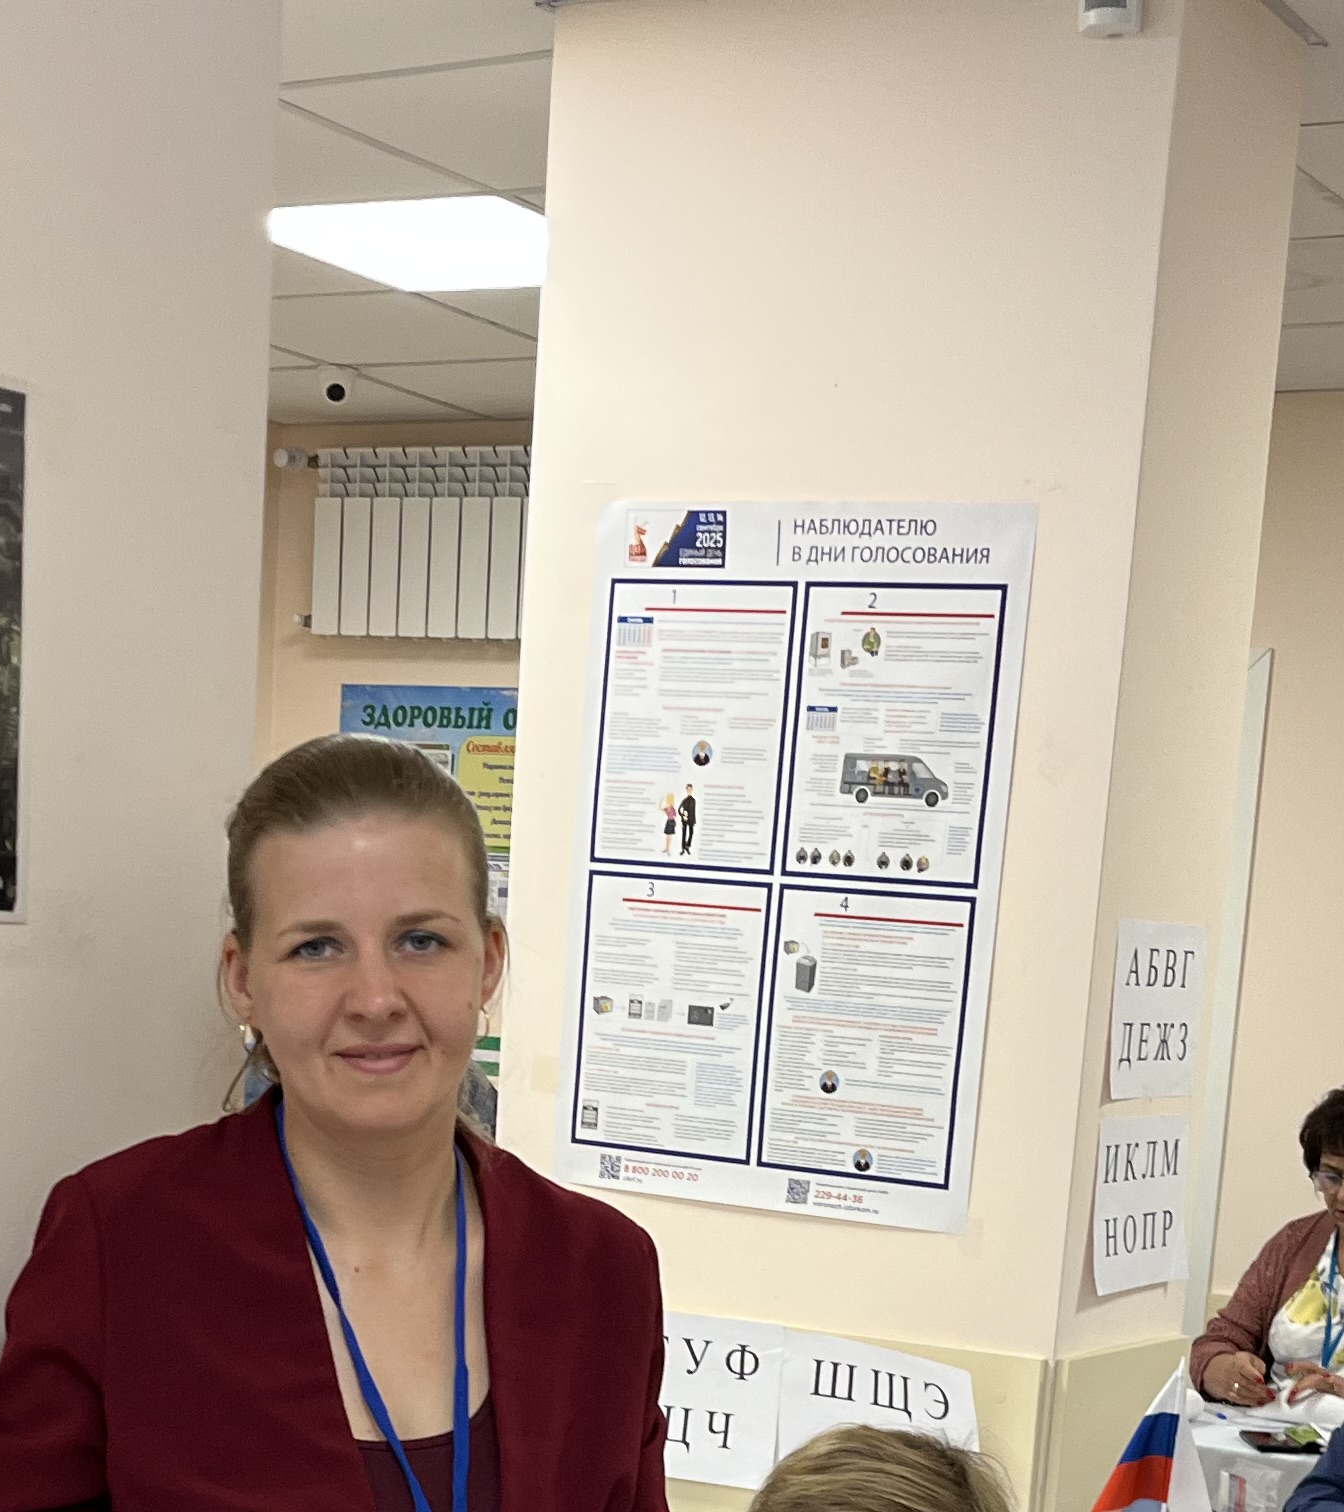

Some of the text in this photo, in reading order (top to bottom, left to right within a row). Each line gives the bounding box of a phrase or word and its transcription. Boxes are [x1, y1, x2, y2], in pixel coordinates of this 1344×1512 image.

[793, 518, 936, 538] НАБЛЮДАТЕЛЮ
[696, 532, 723, 547] 2025
[792, 546, 990, 564] В ДНИ ГОЛОСОВАНИЯ
[672, 589, 676, 604] 1
[868, 593, 877, 608] 2
[361, 700, 493, 730] ЗДОРОВЫЙ
[647, 882, 655, 897] 3
[841, 897, 849, 912] 4
